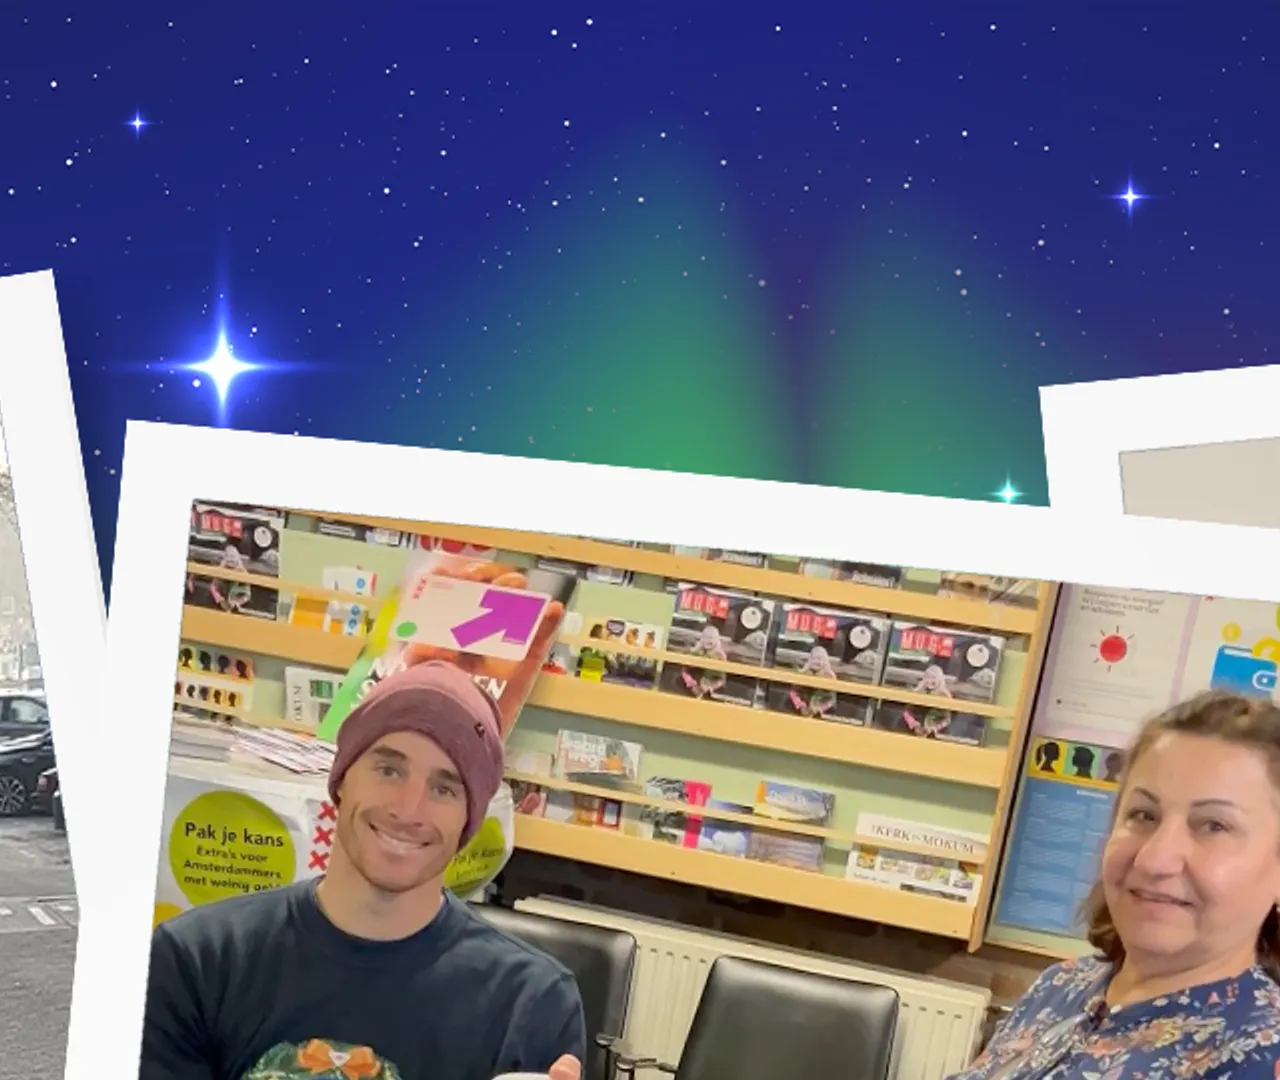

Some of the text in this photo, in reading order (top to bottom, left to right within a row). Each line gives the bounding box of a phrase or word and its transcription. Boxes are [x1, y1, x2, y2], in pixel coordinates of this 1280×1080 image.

[185, 822, 284, 847] Pak je kans
[923, 834, 975, 854] MOKUM
[240, 853, 268, 862] voor
[184, 860, 281, 879] Amsterdammers
[184, 875, 206, 885] met
